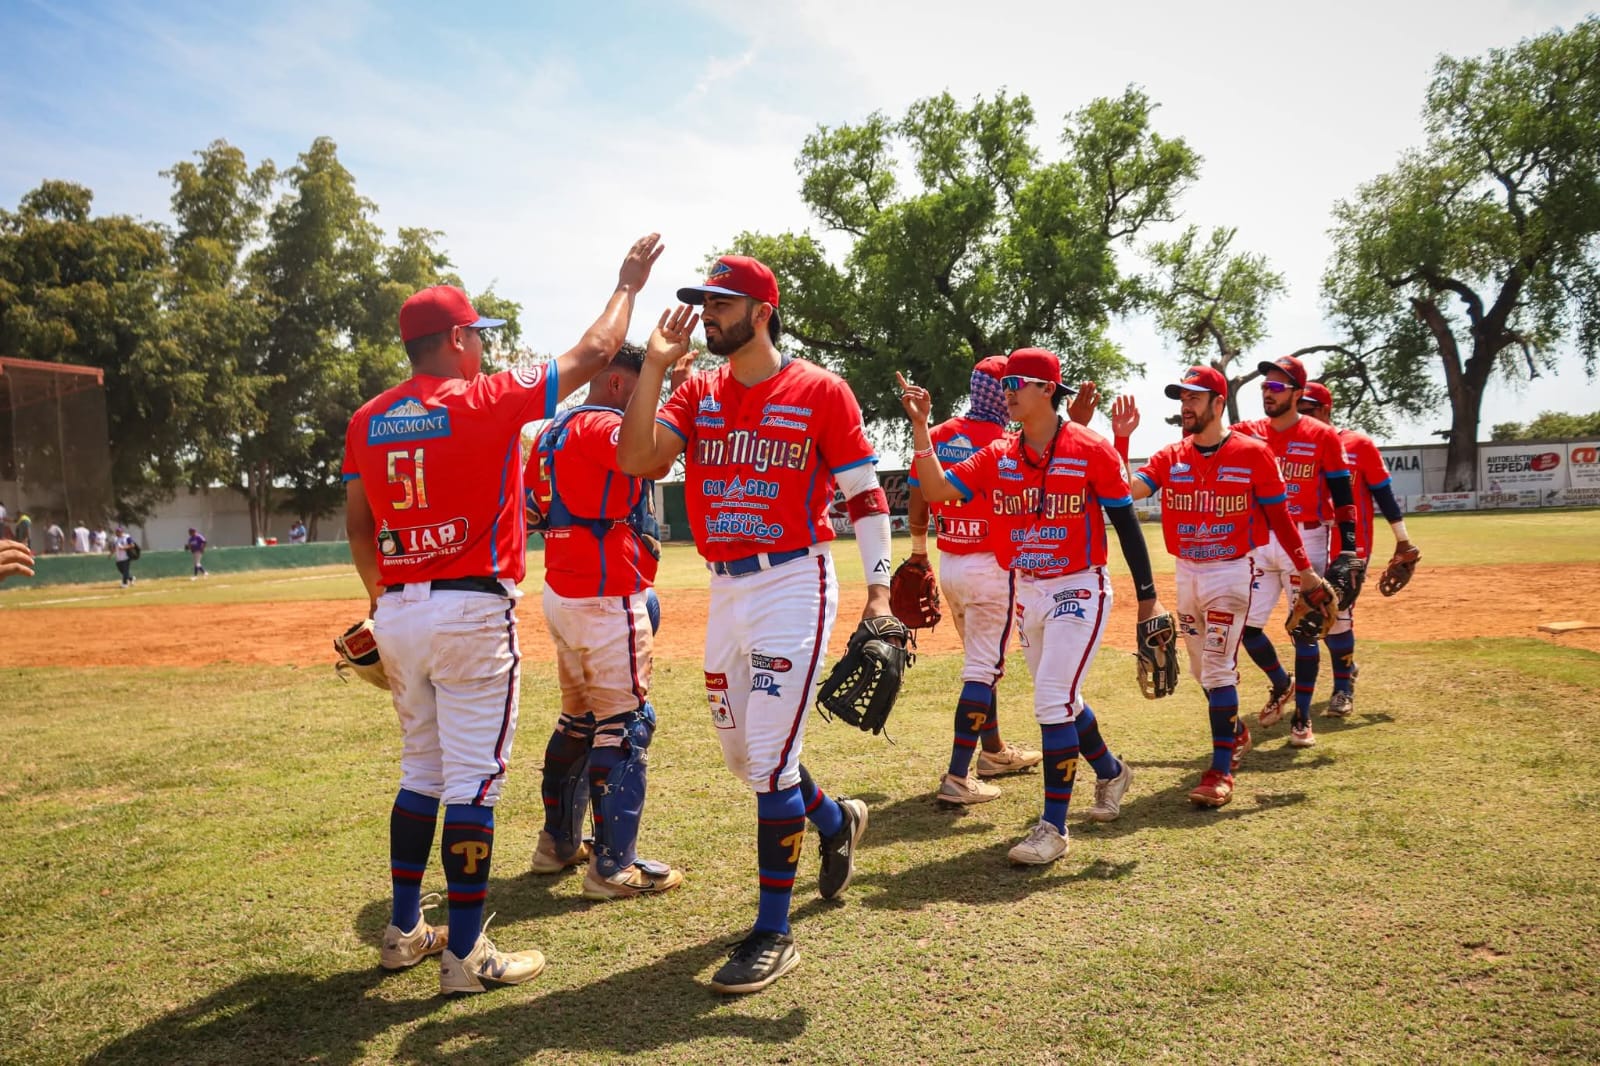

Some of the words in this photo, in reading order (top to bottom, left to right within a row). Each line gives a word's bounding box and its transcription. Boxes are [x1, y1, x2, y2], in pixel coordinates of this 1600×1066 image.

[370, 416, 446, 439] LONGMONT
[1383, 455, 1420, 471] YALA
[1488, 462, 1531, 473] ZEPEDA
[386, 448, 428, 510] 51
[1166, 488, 1192, 511] San
[409, 524, 456, 552] JAR
[948, 521, 981, 536] JAR
[1056, 602, 1078, 615] FUD
